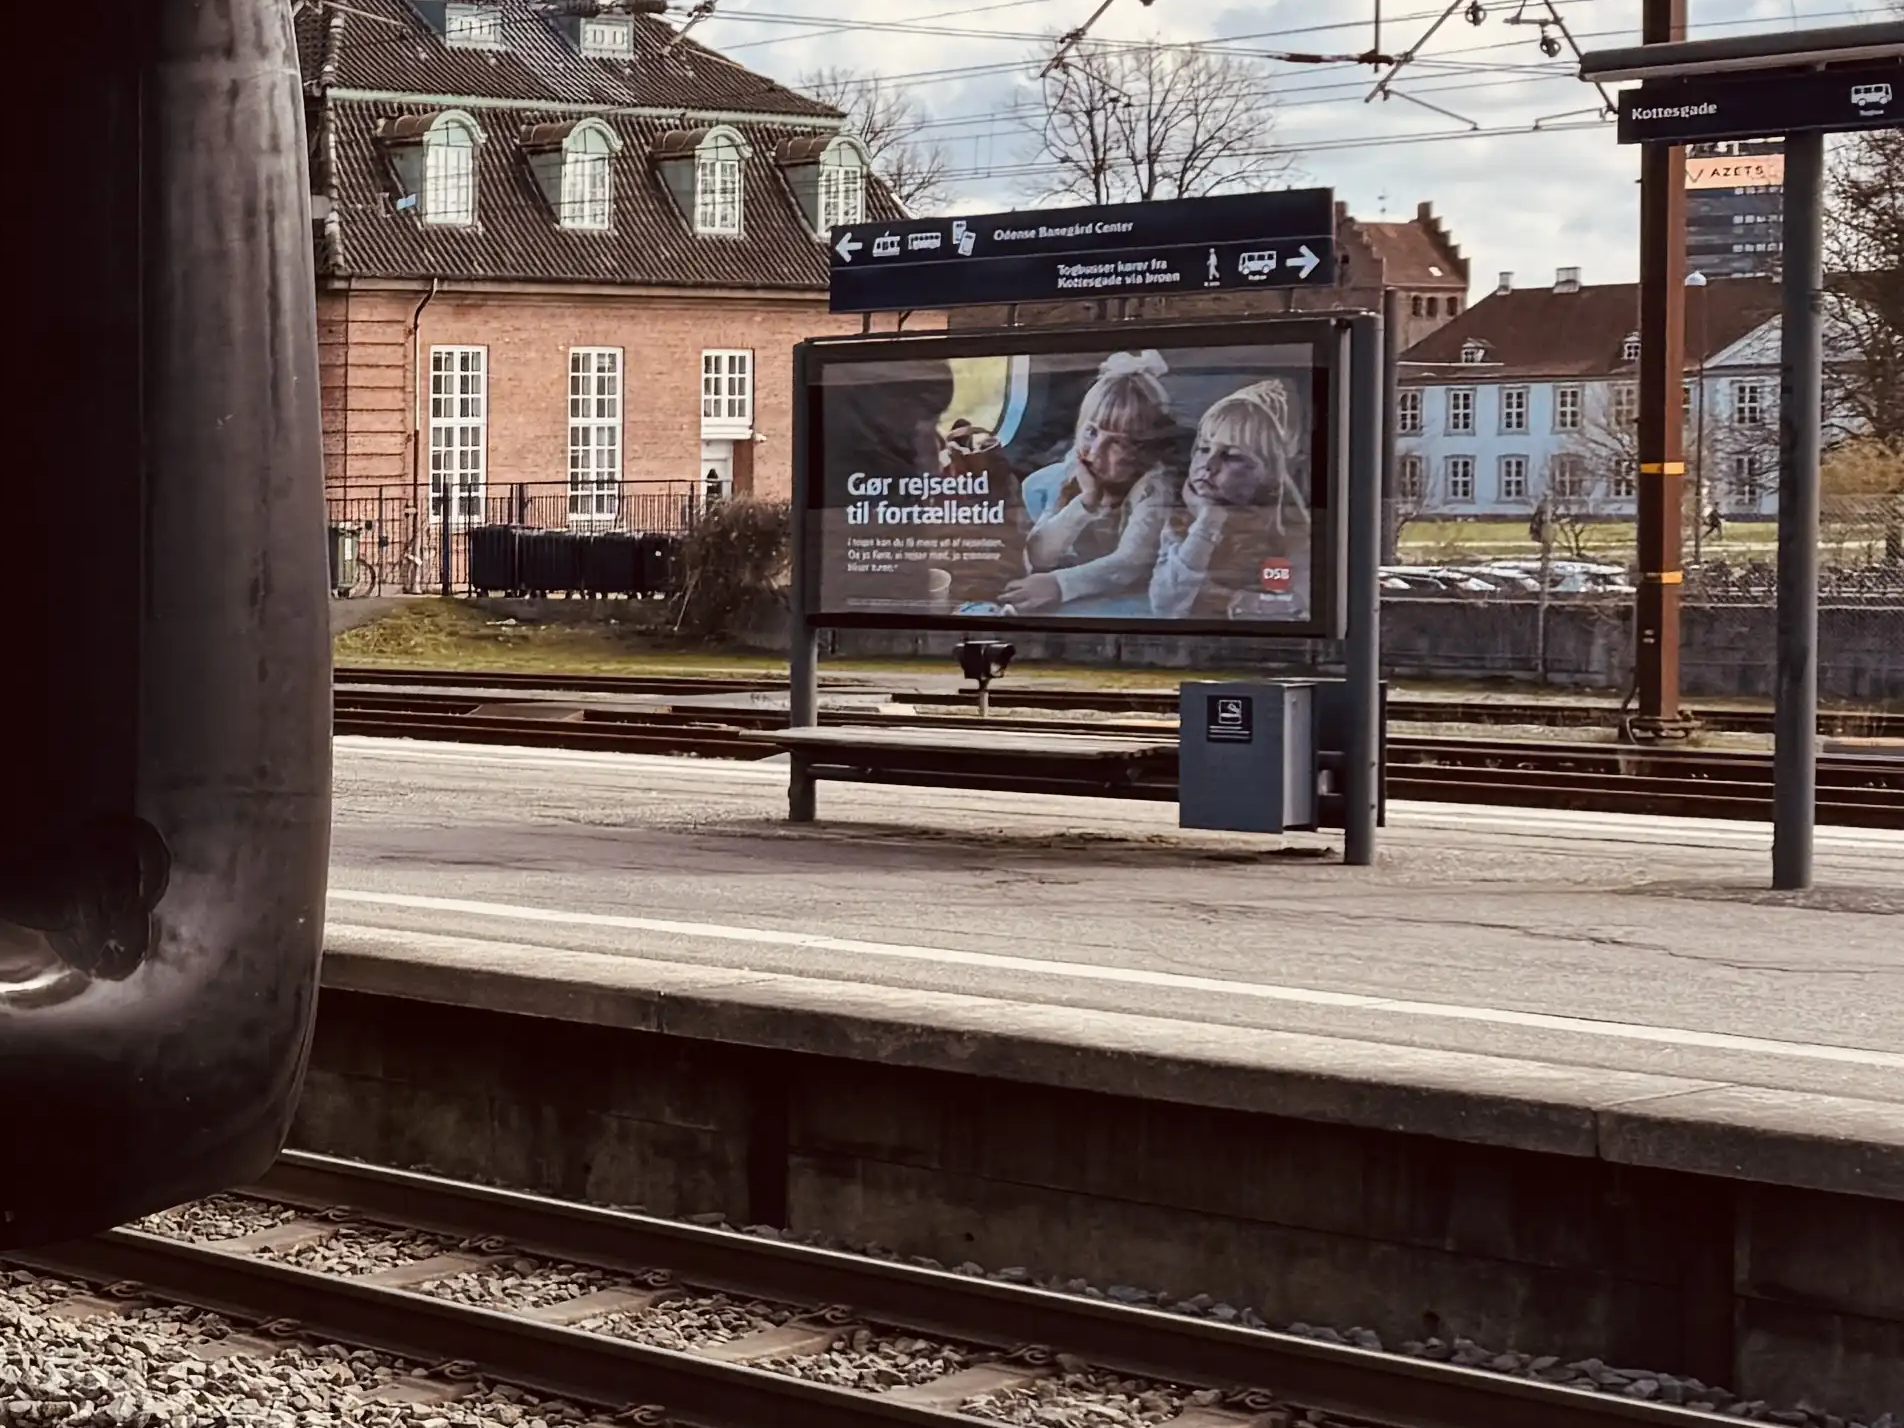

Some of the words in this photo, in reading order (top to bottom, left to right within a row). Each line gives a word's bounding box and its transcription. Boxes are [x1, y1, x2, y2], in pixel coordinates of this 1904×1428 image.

[1632, 102, 1718, 120] Kottesgade
[1710, 165, 1764, 178] AZETS
[993, 229, 1036, 241] Odense
[1095, 222, 1134, 233] Center
[847, 472, 892, 496] Gør
[898, 470, 990, 500] rejsetid
[846, 501, 870, 524] til
[876, 500, 1005, 525] fortælletid
[1263, 568, 1290, 580] DSB
